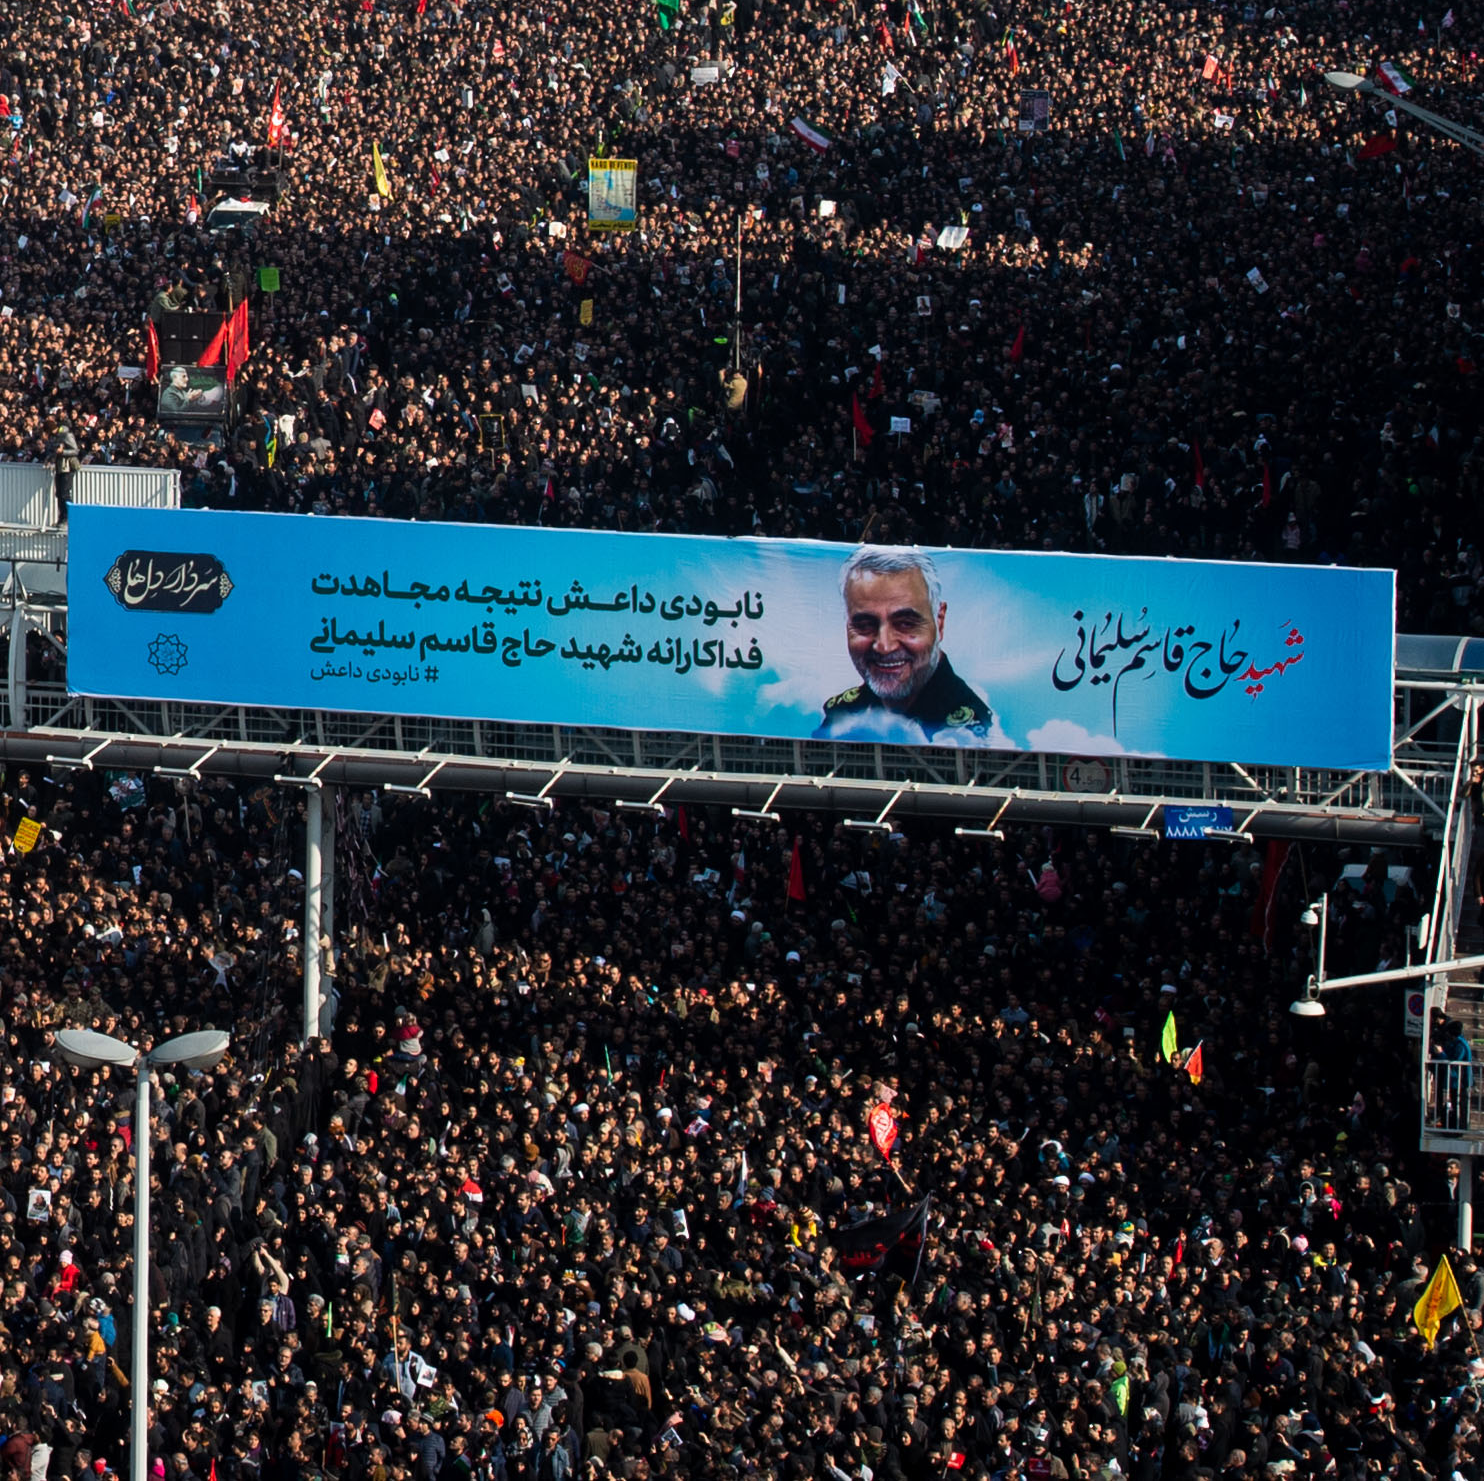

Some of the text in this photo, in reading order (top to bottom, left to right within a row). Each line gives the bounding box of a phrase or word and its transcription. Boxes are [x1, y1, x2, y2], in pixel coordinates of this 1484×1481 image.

[311, 569, 764, 627] نابودی داعش نتیجه مجاهدت
[309, 616, 764, 674] فداکارانه شهید حاج قاسم سلیمانی
[310, 660, 363, 682] داعش
[366, 662, 420, 686] نابودی
